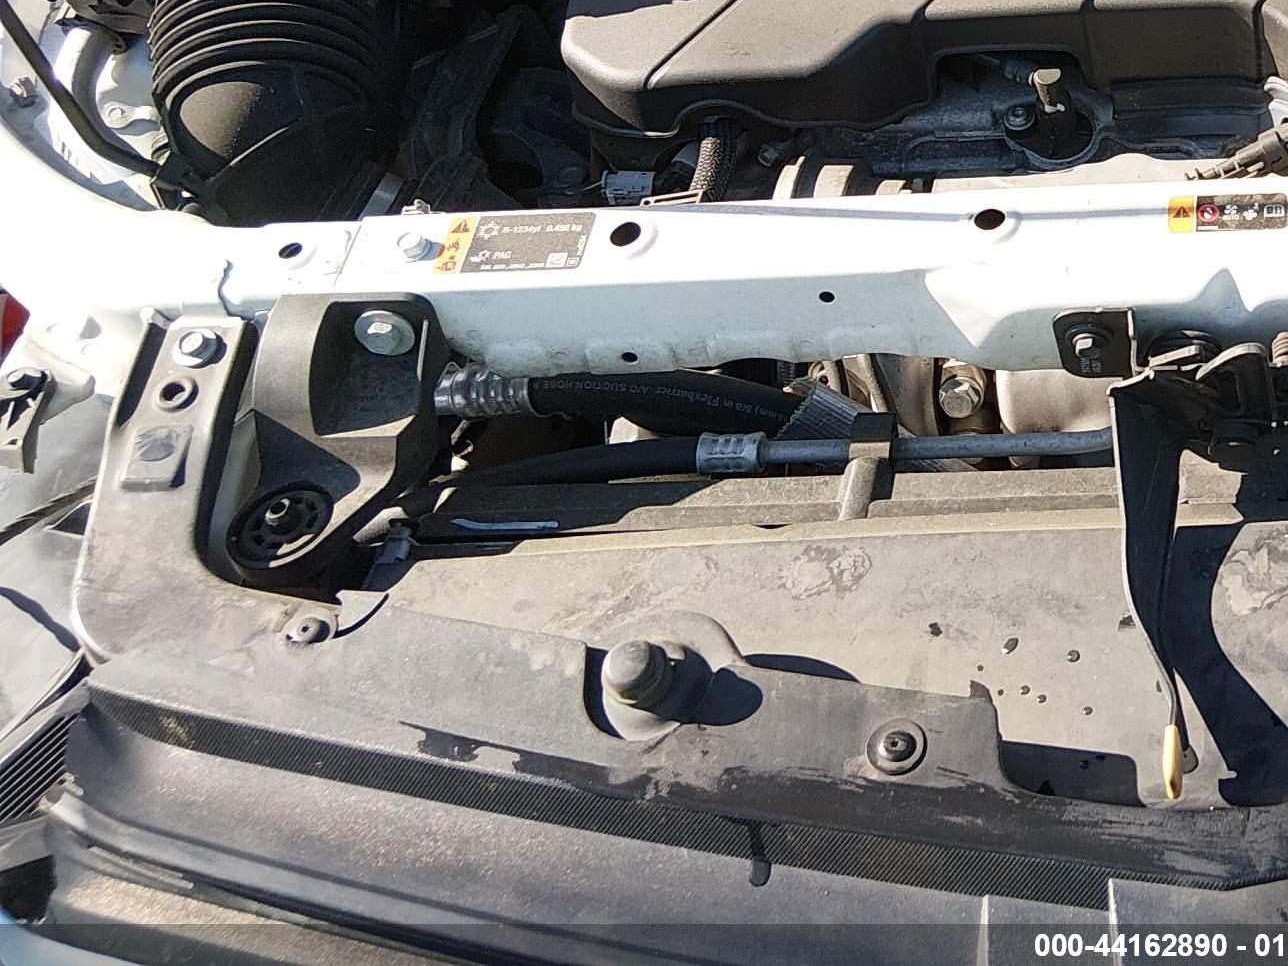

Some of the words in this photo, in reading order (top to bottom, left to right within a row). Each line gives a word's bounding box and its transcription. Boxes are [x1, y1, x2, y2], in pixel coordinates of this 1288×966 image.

[502, 224, 541, 234] R-1234yf
[570, 223, 583, 234] kg
[492, 250, 512, 259] PAG
